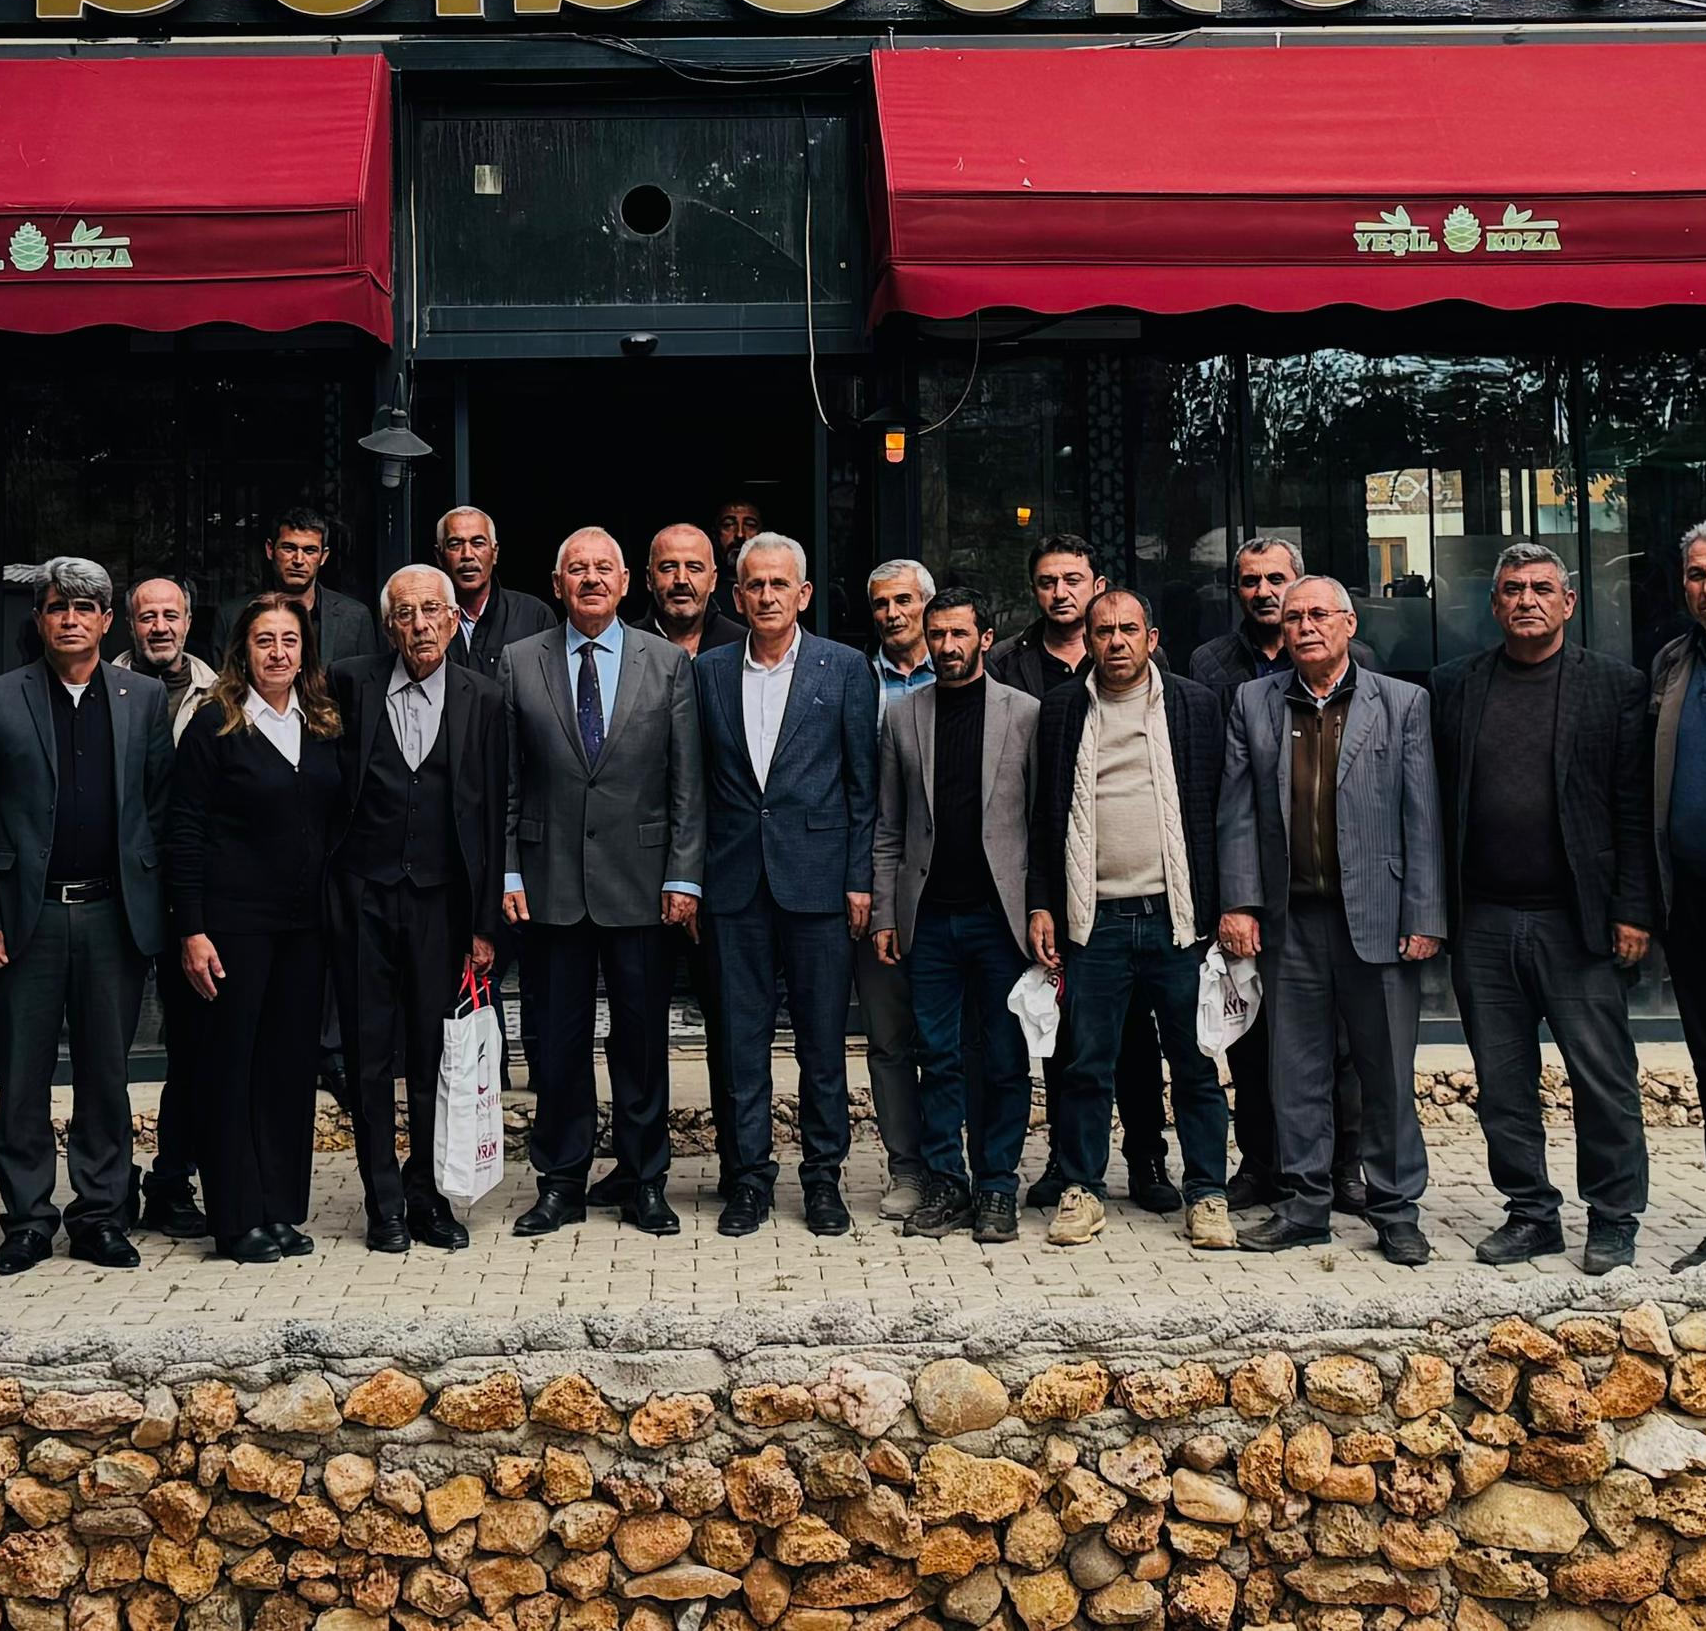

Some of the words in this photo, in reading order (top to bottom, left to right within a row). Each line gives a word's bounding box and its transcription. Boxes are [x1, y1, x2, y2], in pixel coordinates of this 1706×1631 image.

[1353, 228, 1439, 257] YEŞİL
[1485, 231, 1562, 252] KOZA
[53, 248, 134, 270] KOZA
